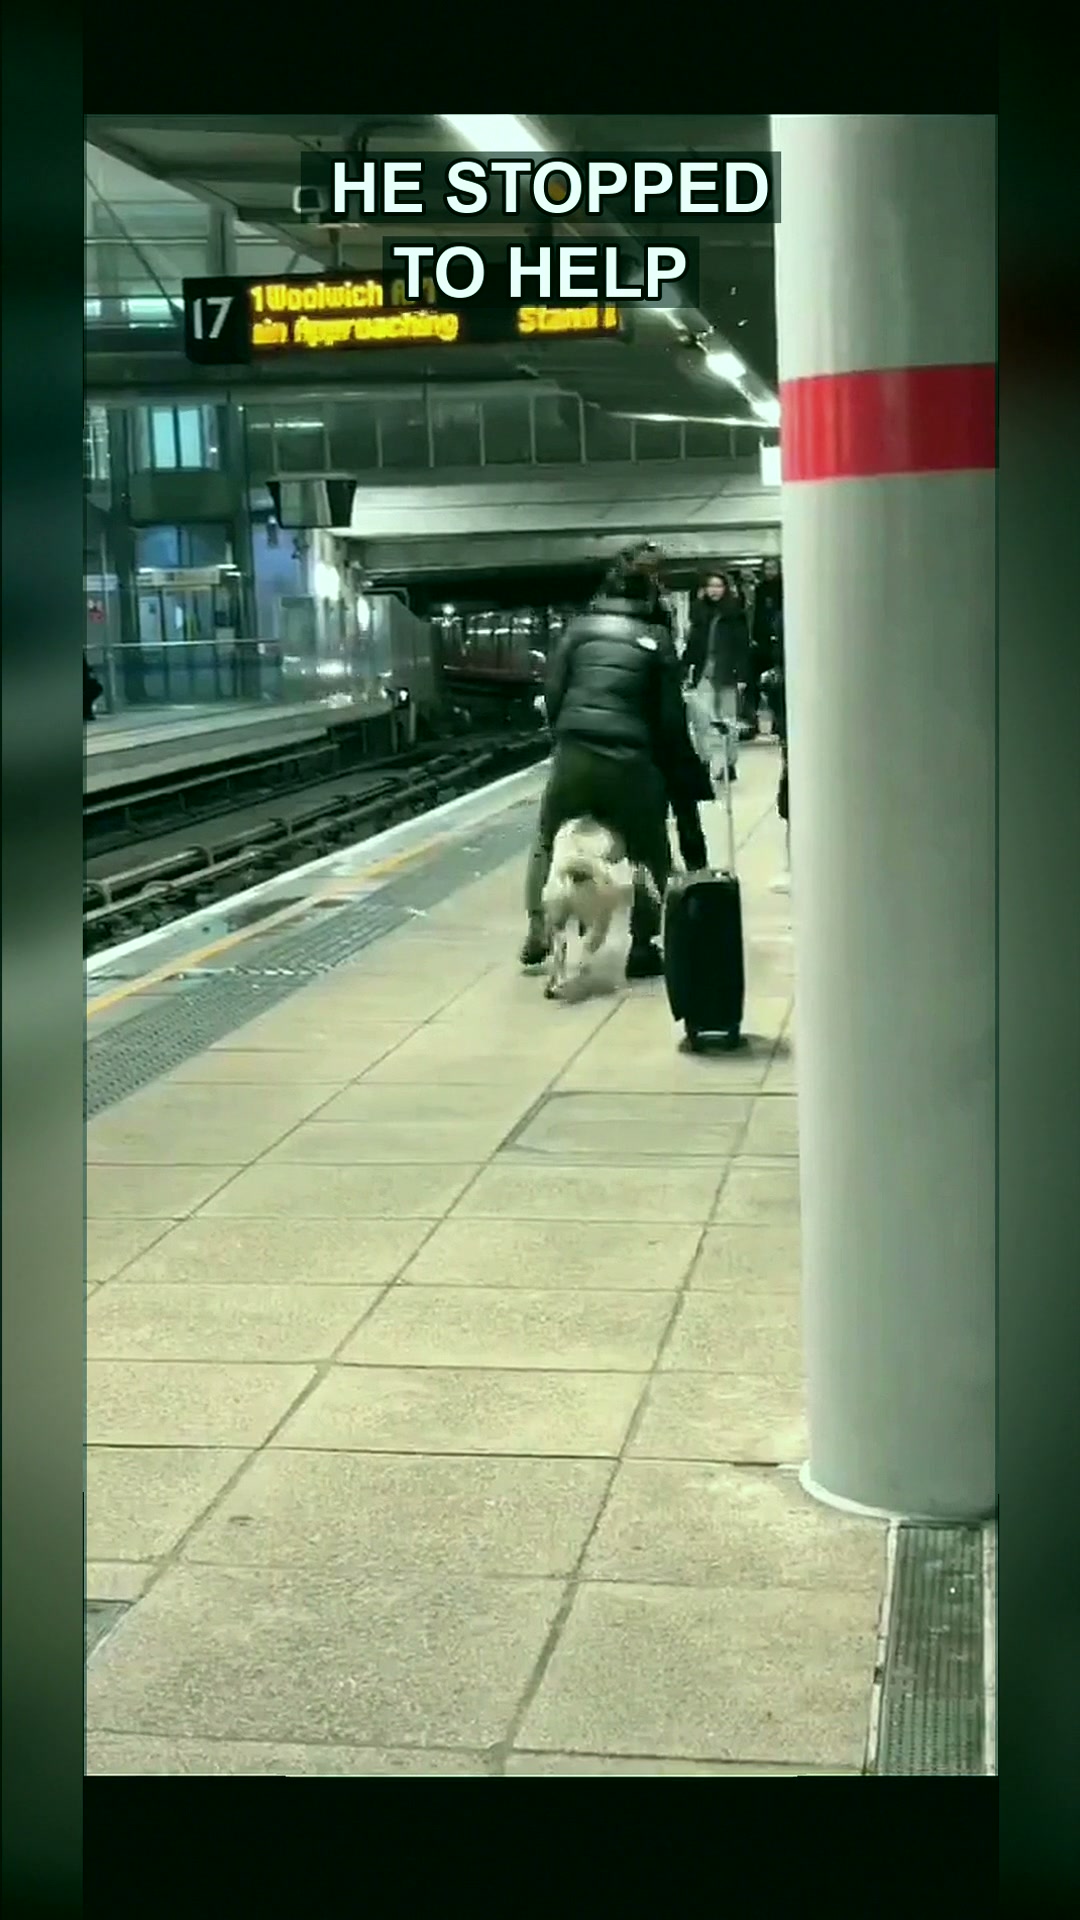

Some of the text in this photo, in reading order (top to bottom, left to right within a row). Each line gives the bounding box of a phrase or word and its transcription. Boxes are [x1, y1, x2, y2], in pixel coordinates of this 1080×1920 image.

[265, 280, 384, 311] Woolwich
[192, 296, 235, 340] 17
[293, 311, 459, 347] Approaching
